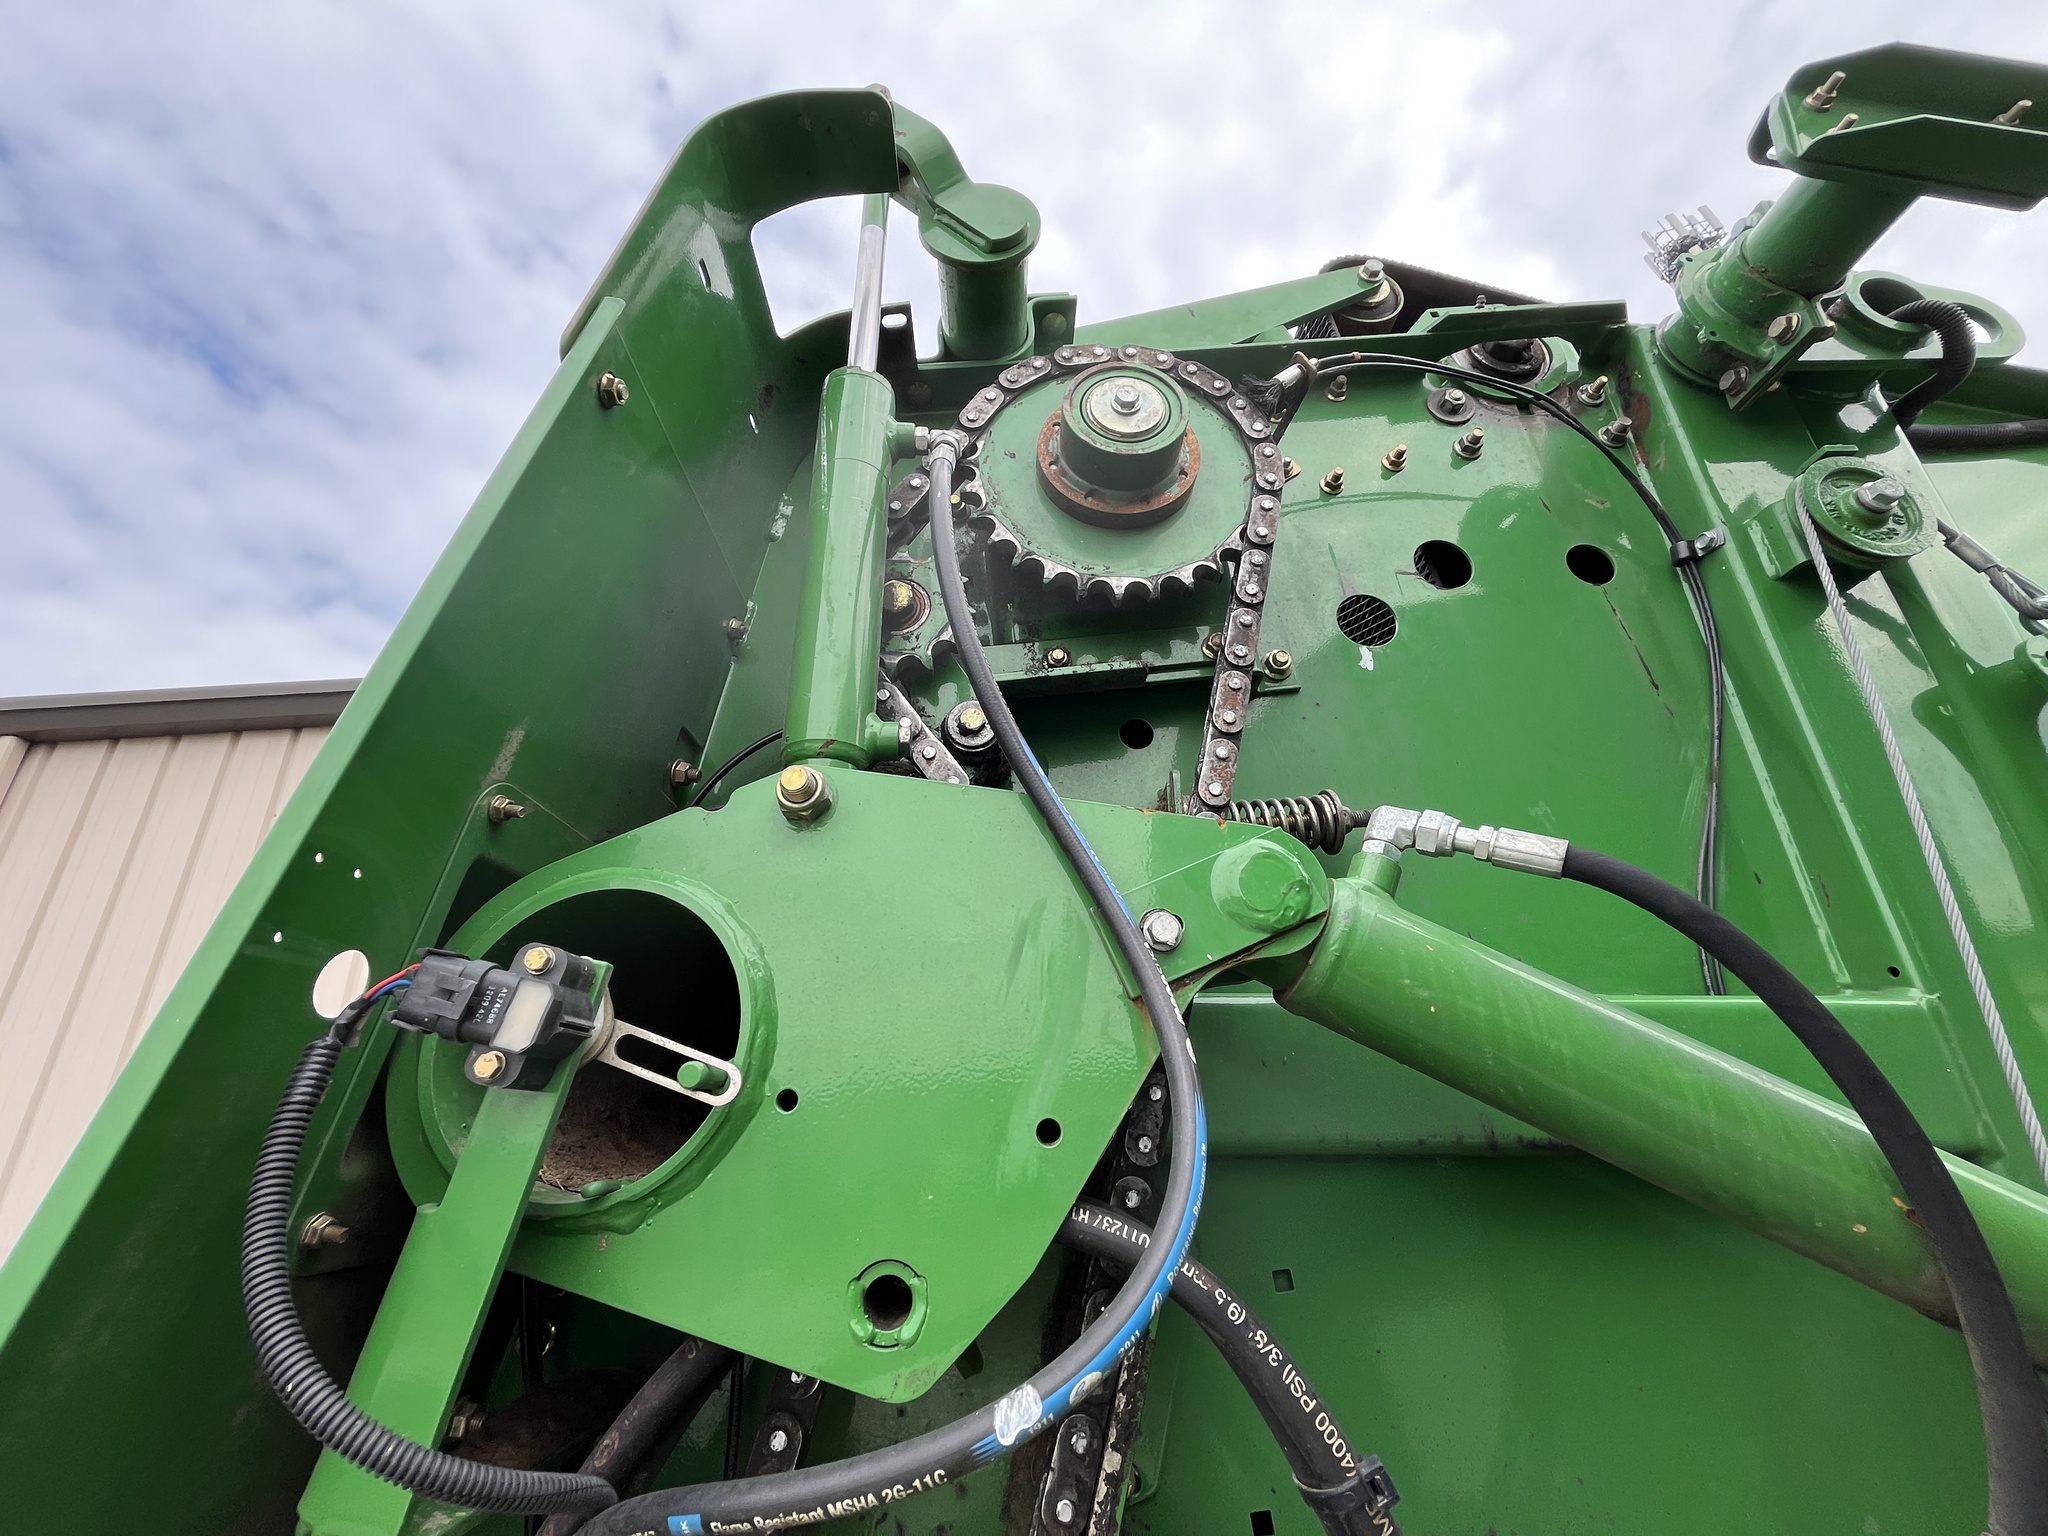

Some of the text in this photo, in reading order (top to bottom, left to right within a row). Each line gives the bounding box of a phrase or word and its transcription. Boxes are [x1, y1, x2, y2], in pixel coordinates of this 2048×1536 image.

[1282, 1363, 1317, 1414] PSI)
[1315, 1411, 1357, 1477] (4000
[826, 1492, 879, 1518] MSHA
[881, 1468, 949, 1501] 2G-11C
